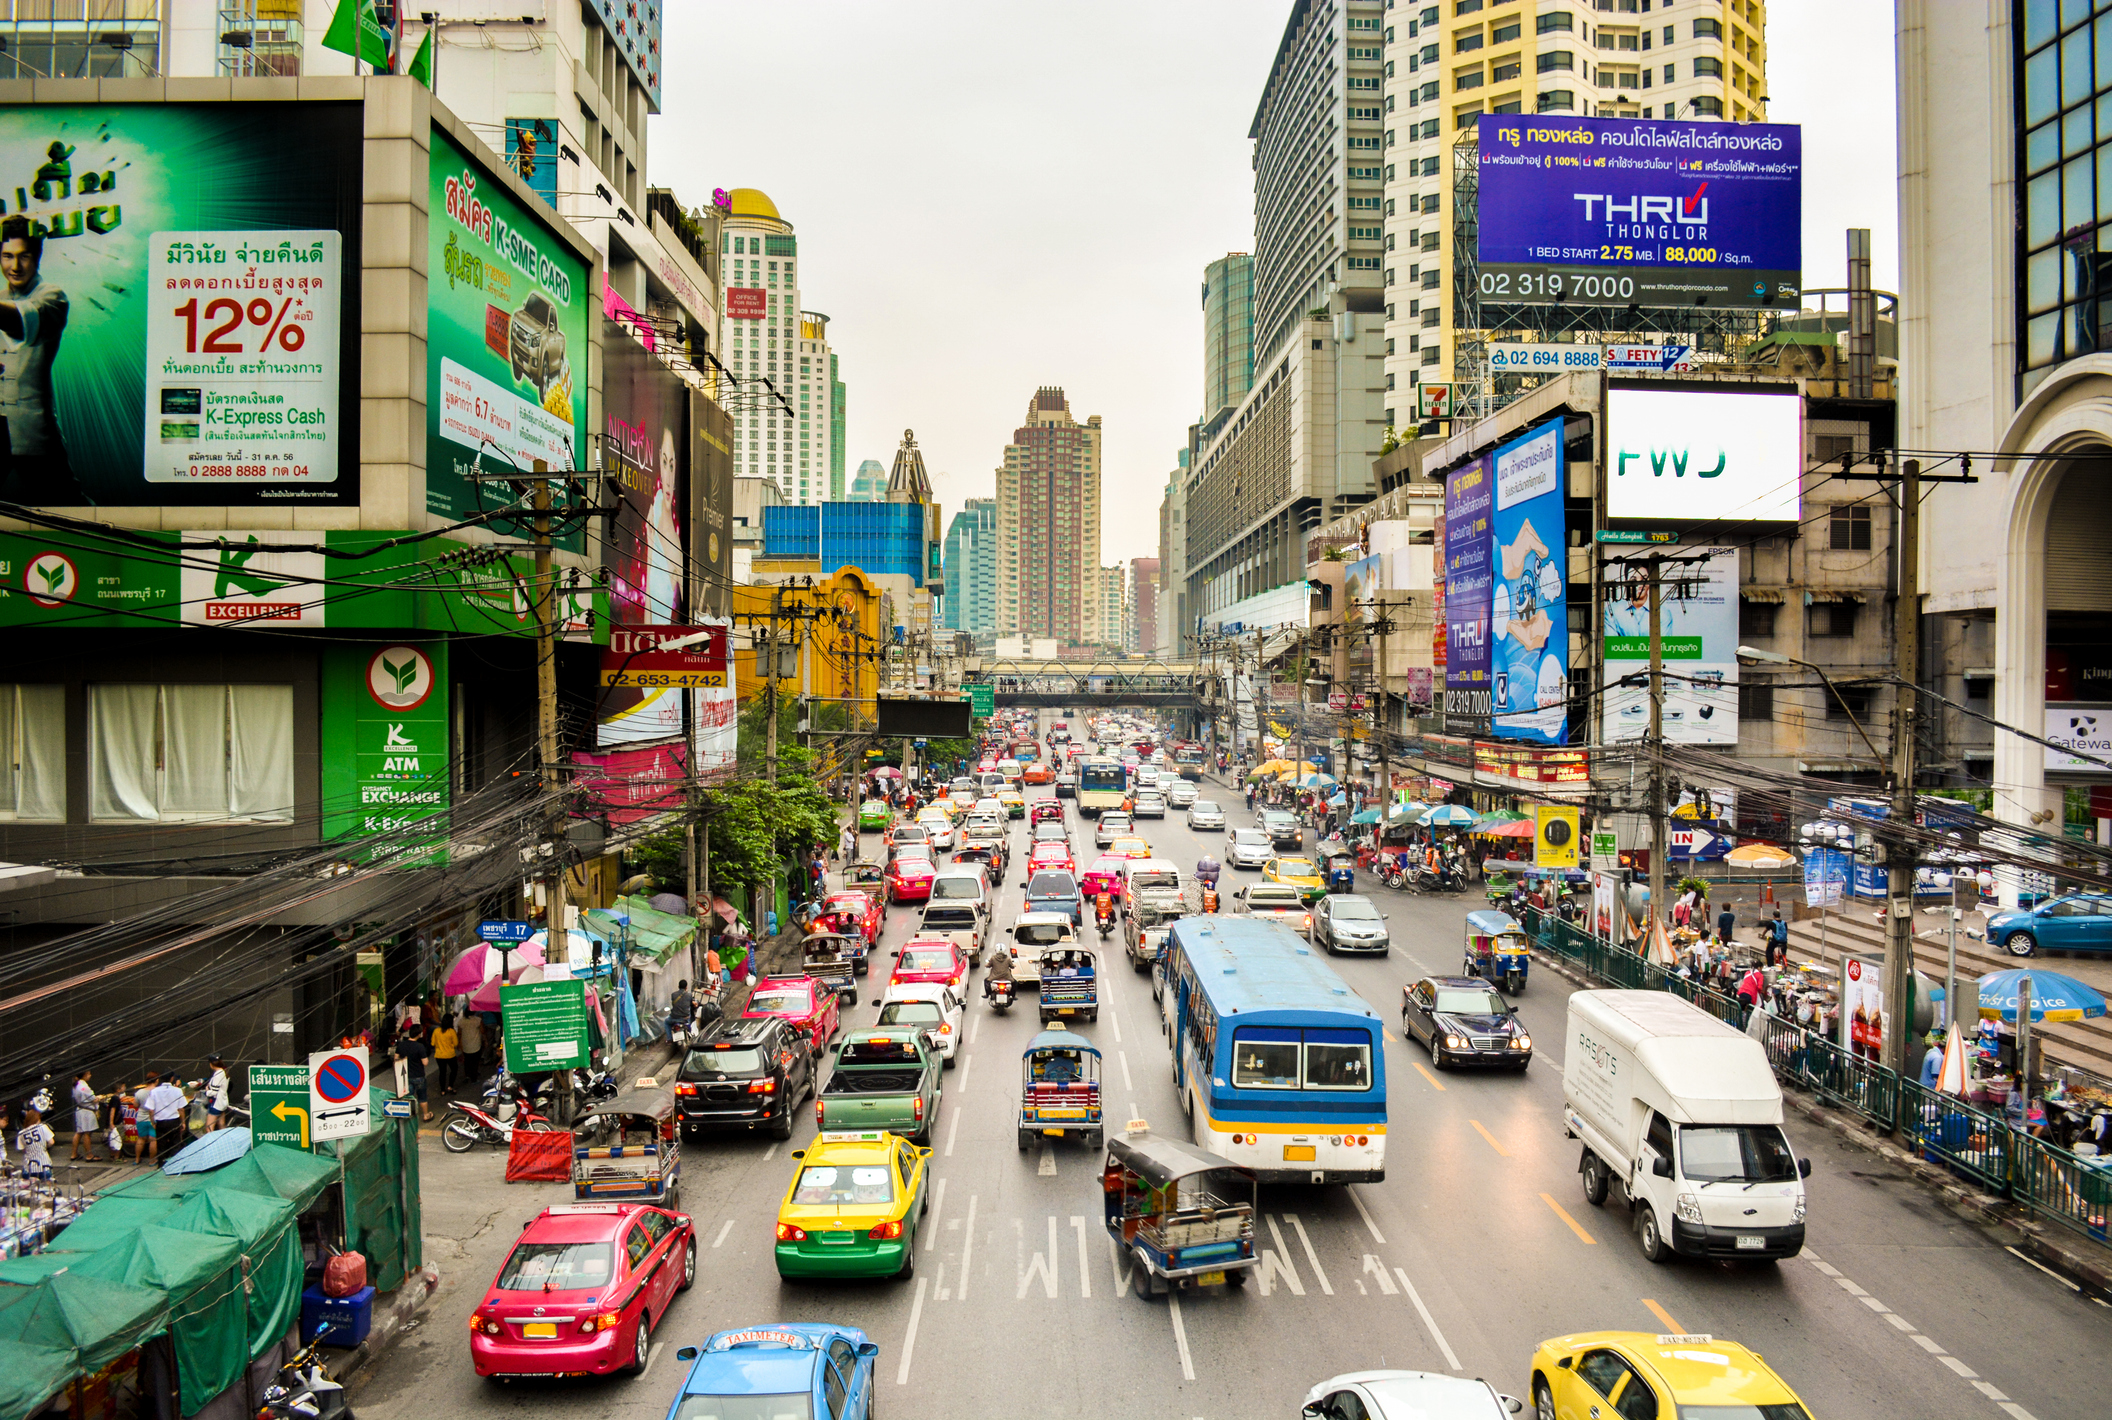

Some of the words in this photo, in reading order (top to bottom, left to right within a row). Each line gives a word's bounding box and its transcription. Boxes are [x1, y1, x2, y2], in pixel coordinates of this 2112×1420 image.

[1499, 128, 1521, 147] ทรู
[1527, 126, 1594, 144] ทองหล่อ
[1601, 126, 1782, 151] คอนโดไลฟ์สไตล์ทองหล่อ
[1492, 154, 1541, 168] พร้อมเข้าอยู่
[1554, 156, 1579, 167] 100%
[1593, 157, 1606, 168] ฟรี
[1690, 160, 1703, 171] ฟรี
[446, 169, 492, 244] สมัคร
[496, 219, 537, 279] K-SME
[540, 257, 570, 304] CARD
[1606, 224, 1708, 240] THONGLOR
[167, 242, 227, 264] มีวินัย
[235, 241, 323, 263] จ่ายคืนดี
[1536, 247, 1560, 258] BED
[1562, 248, 1598, 259] START
[1600, 245, 1633, 260] 2.75
[1636, 250, 1655, 261] MB.
[1665, 247, 1717, 264] 88,000
[1725, 253, 1753, 265] Sq.m.
[444, 231, 483, 290] ลุ้นรถ
[166, 267, 323, 295] ลดดอกเบี้ยสูงสุด
[1480, 273, 1510, 294] 02
[1518, 274, 1562, 295] 319
[1570, 275, 1634, 298] 7000
[1510, 351, 1528, 365] 02
[1533, 351, 1559, 365] 694
[1564, 352, 1599, 367] 8888
[1663, 347, 1679, 359] 12
[162, 356, 235, 374] หั่นดอกเบี้ย
[239, 360, 323, 374] สะท้านวงการ
[206, 391, 284, 405] บัตรกดเงินสด
[1426, 387, 1447, 416] 7
[475, 397, 489, 421] 6.7
[206, 408, 283, 428] K-Express
[287, 407, 326, 425] Cash
[251, 453, 261, 461] 31
[283, 453, 294, 461] 56
[173, 466, 189, 477] โทร.
[190, 465, 198, 477] 0
[201, 465, 233, 477] 2888
[236, 465, 267, 477] 8888
[272, 466, 290, 477] กด
[293, 465, 309, 477] 04
[97, 577, 121, 585] สาขา
[97, 587, 151, 602] ถนนเพชรบุรี
[154, 590, 166, 598] 17
[208, 605, 299, 619] EXCELLENCE
[607, 674, 722, 686] 02-653-4742
[1447, 690, 1455, 712] 02
[1456, 690, 1470, 713] 319
[1471, 690, 1492, 715] 7000
[383, 757, 420, 771] ATM
[361, 791, 441, 804] EXCHANGE
[1675, 833, 1693, 844] IN
[483, 923, 508, 934] เพชรบุรี
[515, 925, 527, 935] 17
[1978, 993, 2004, 1006] First
[2006, 997, 2067, 1007] Coice
[23, 1129, 42, 1145] 55
